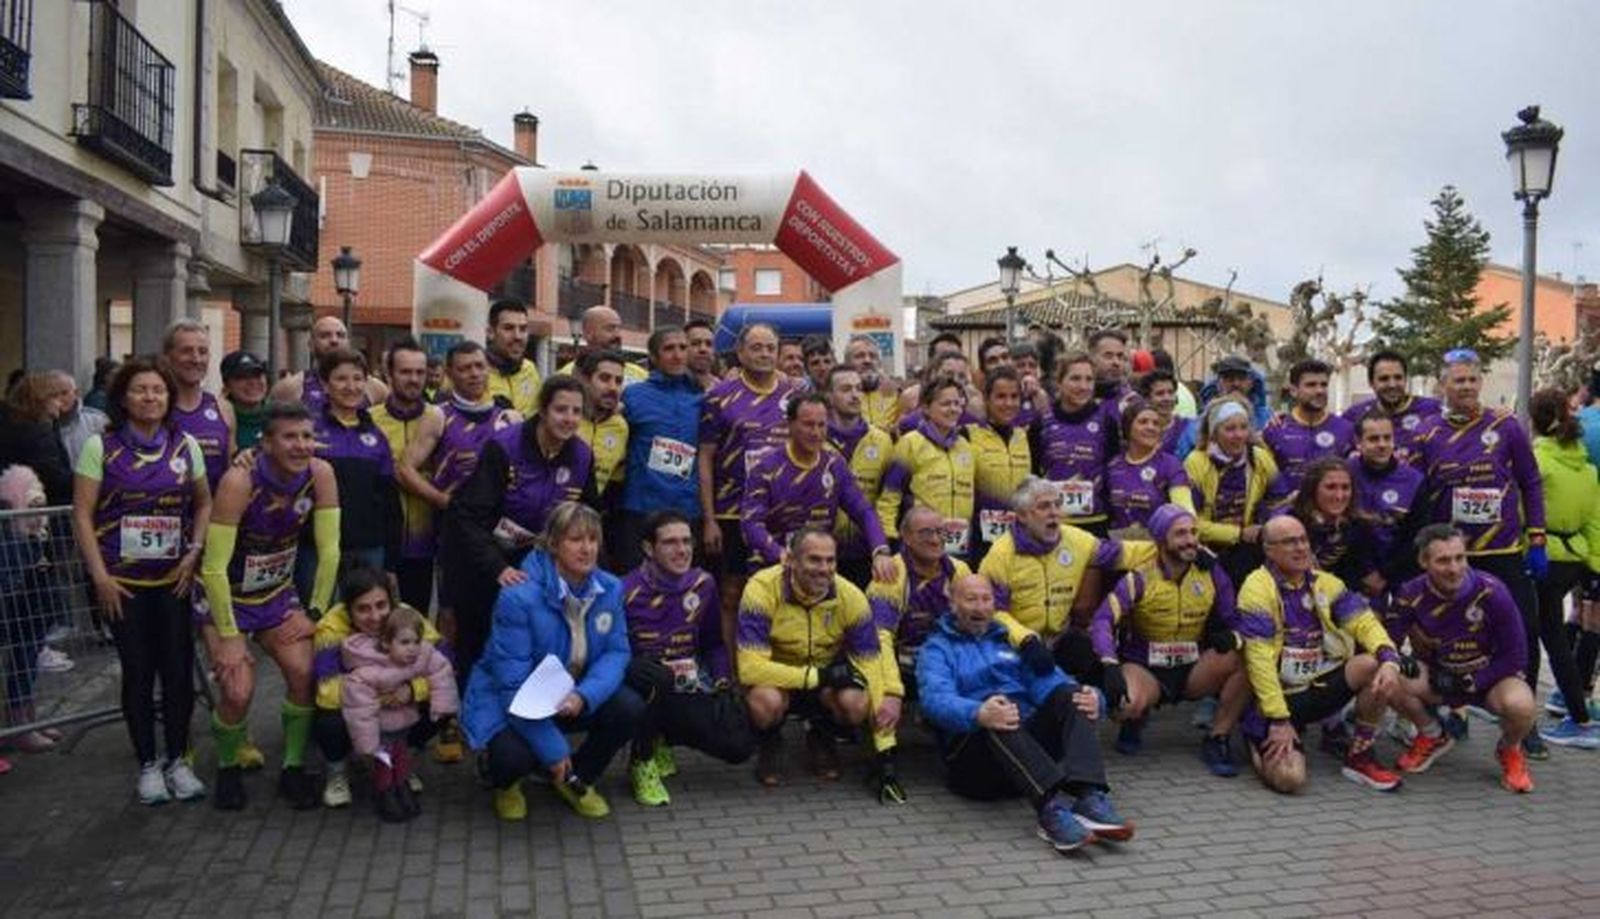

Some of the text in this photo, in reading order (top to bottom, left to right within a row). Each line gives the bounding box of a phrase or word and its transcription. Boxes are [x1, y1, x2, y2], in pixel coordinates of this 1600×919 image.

[606, 178, 738, 205] Diputación
[606, 209, 763, 232] de Salamanca
[796, 199, 821, 219] CON
[445, 246, 467, 269] CON
[476, 202, 520, 243] DEPORTE
[788, 215, 856, 276] DEPORTISTAS
[140, 531, 163, 548] 51
